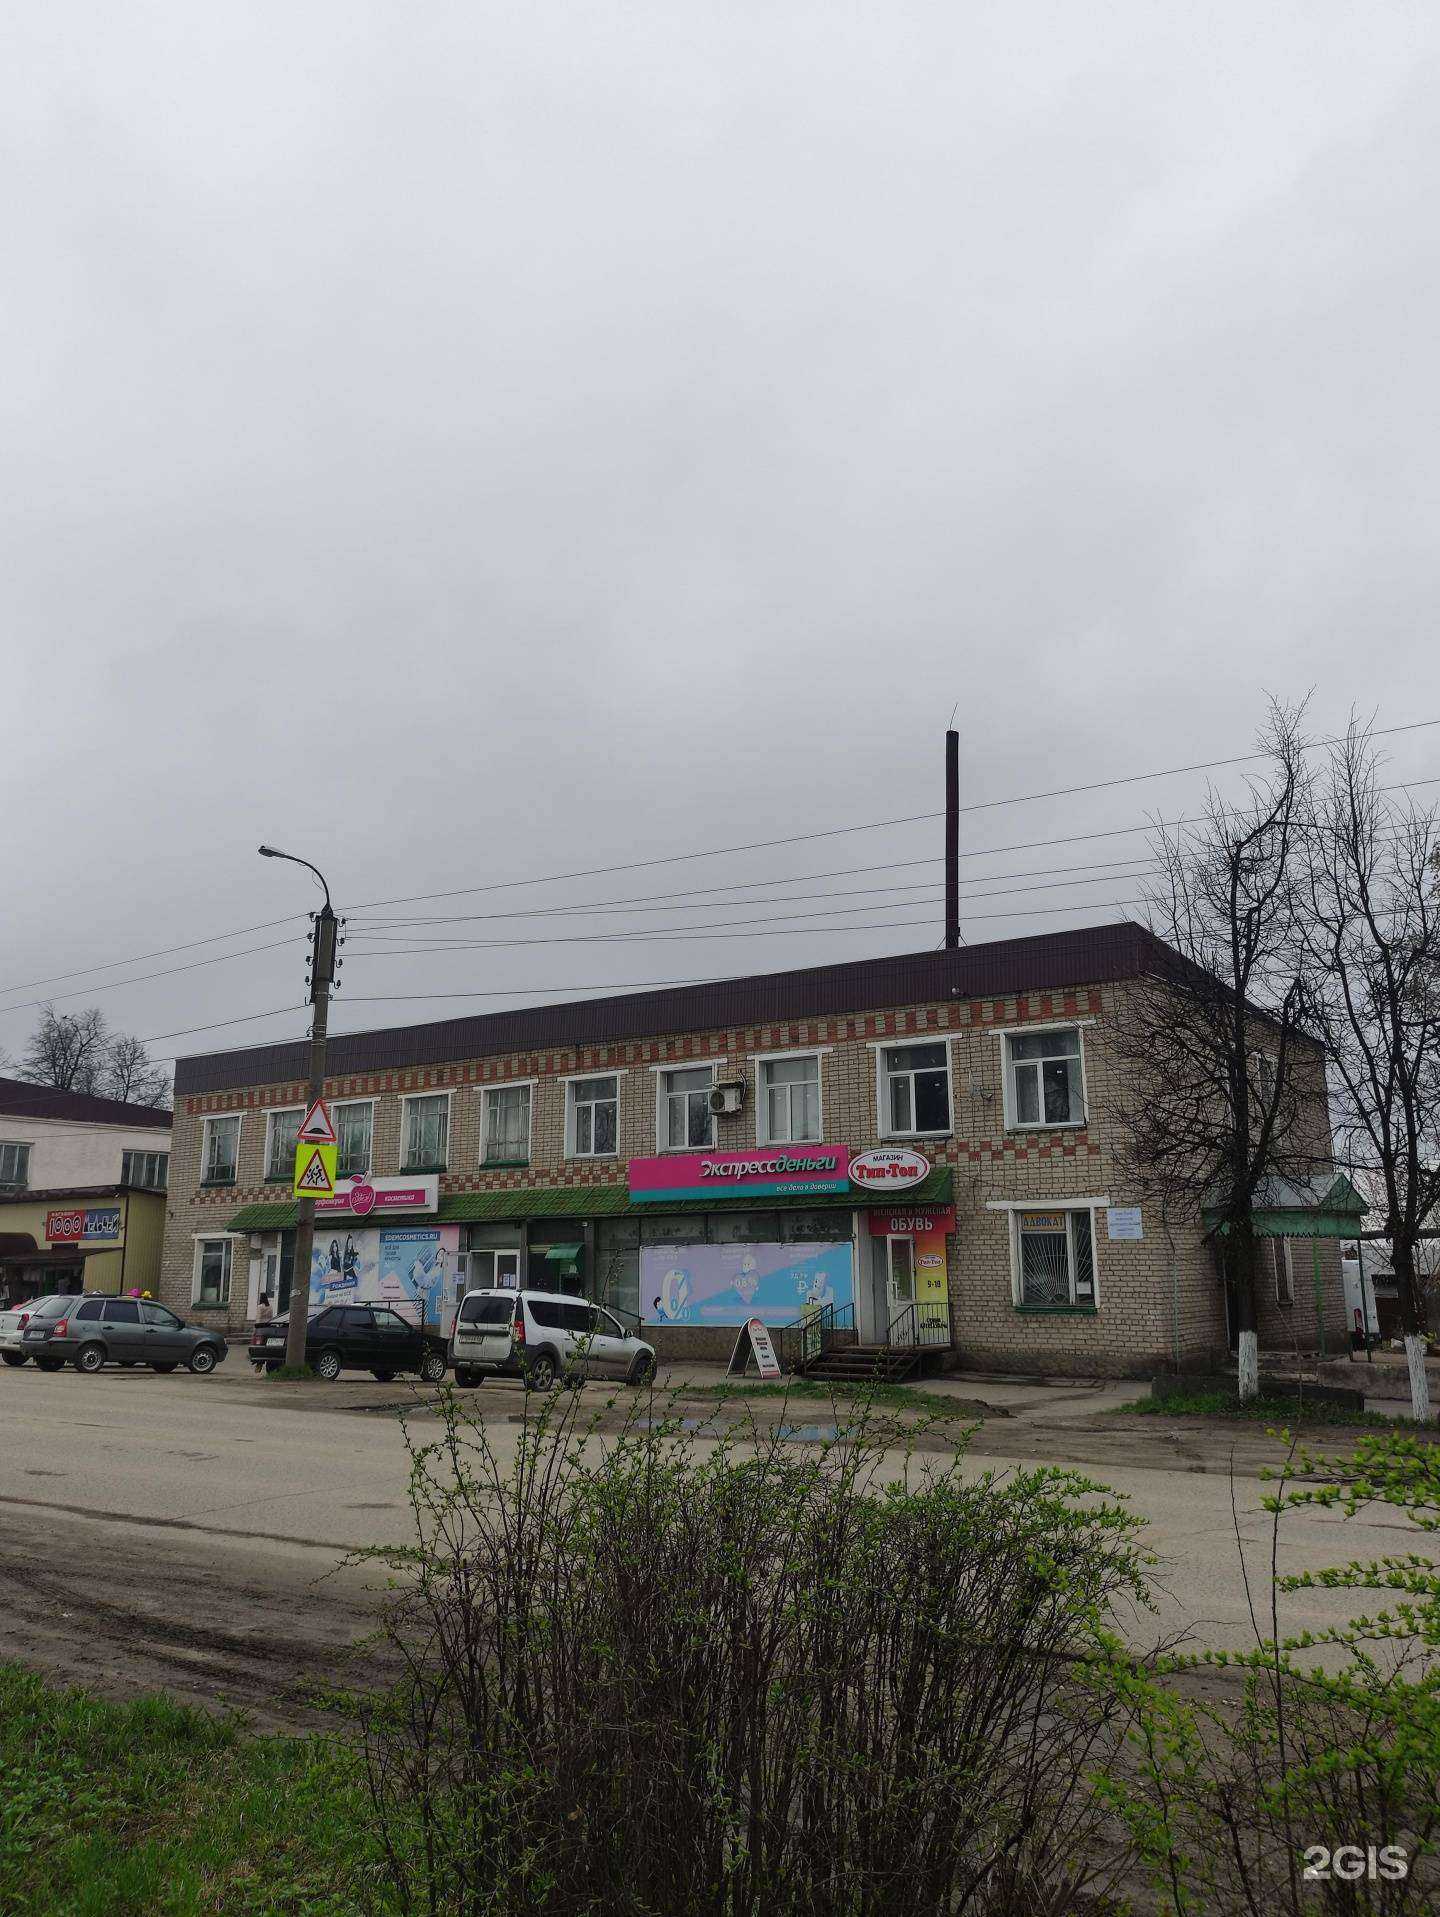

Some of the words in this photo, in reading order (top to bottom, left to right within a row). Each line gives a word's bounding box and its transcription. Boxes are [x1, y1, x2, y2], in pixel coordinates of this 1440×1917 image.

[873, 1154, 904, 1162] МАГАЗИН
[49, 1215, 81, 1237] 1000
[890, 1217, 933, 1231] ОБУВЬ
[1023, 1214, 1064, 1227] АДВОКАТ
